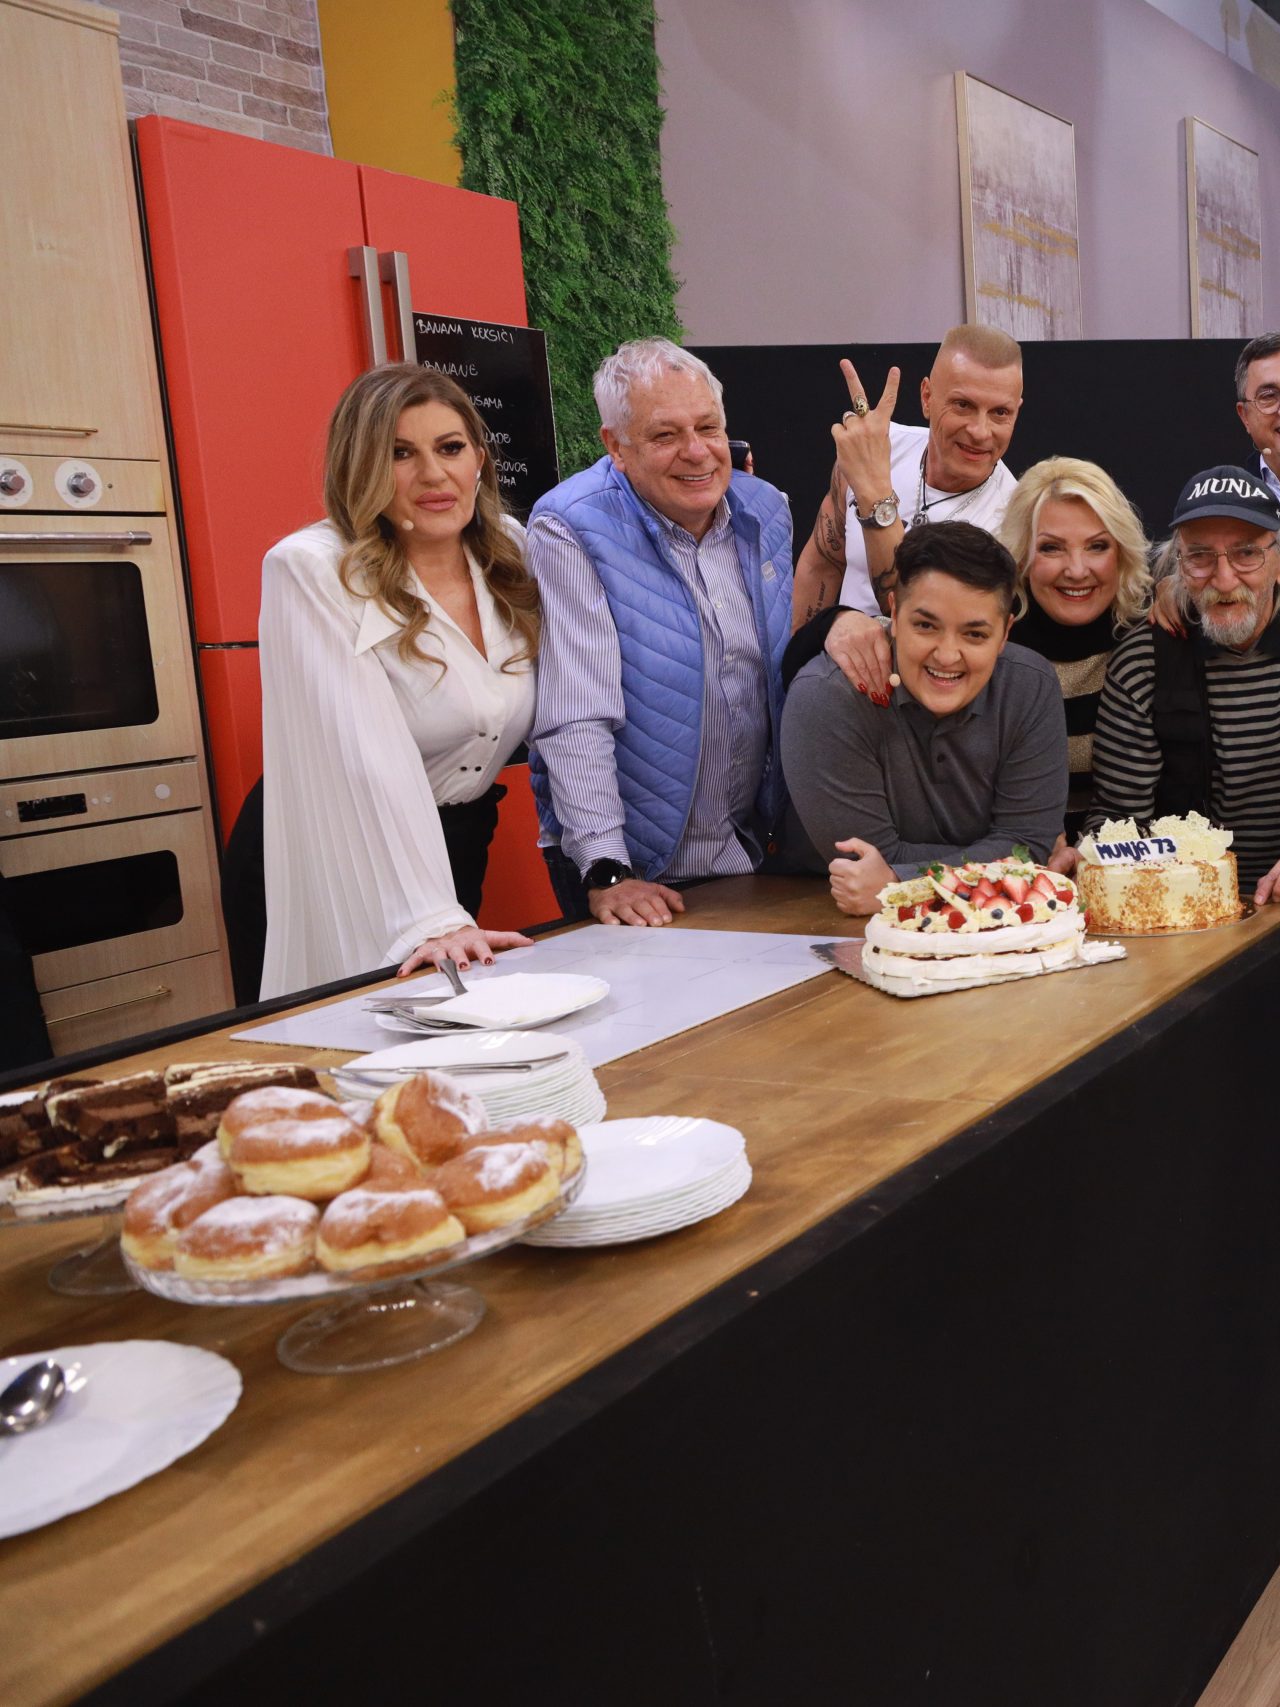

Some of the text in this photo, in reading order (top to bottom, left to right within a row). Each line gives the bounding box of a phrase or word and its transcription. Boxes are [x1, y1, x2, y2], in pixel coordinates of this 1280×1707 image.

[416, 319, 464, 335] BANANA
[470, 395, 503, 410] USAMA
[495, 459, 528, 476] SOVOG
[1187, 477, 1270, 501] MUNJA
[1095, 838, 1176, 861] MUNJA 73
